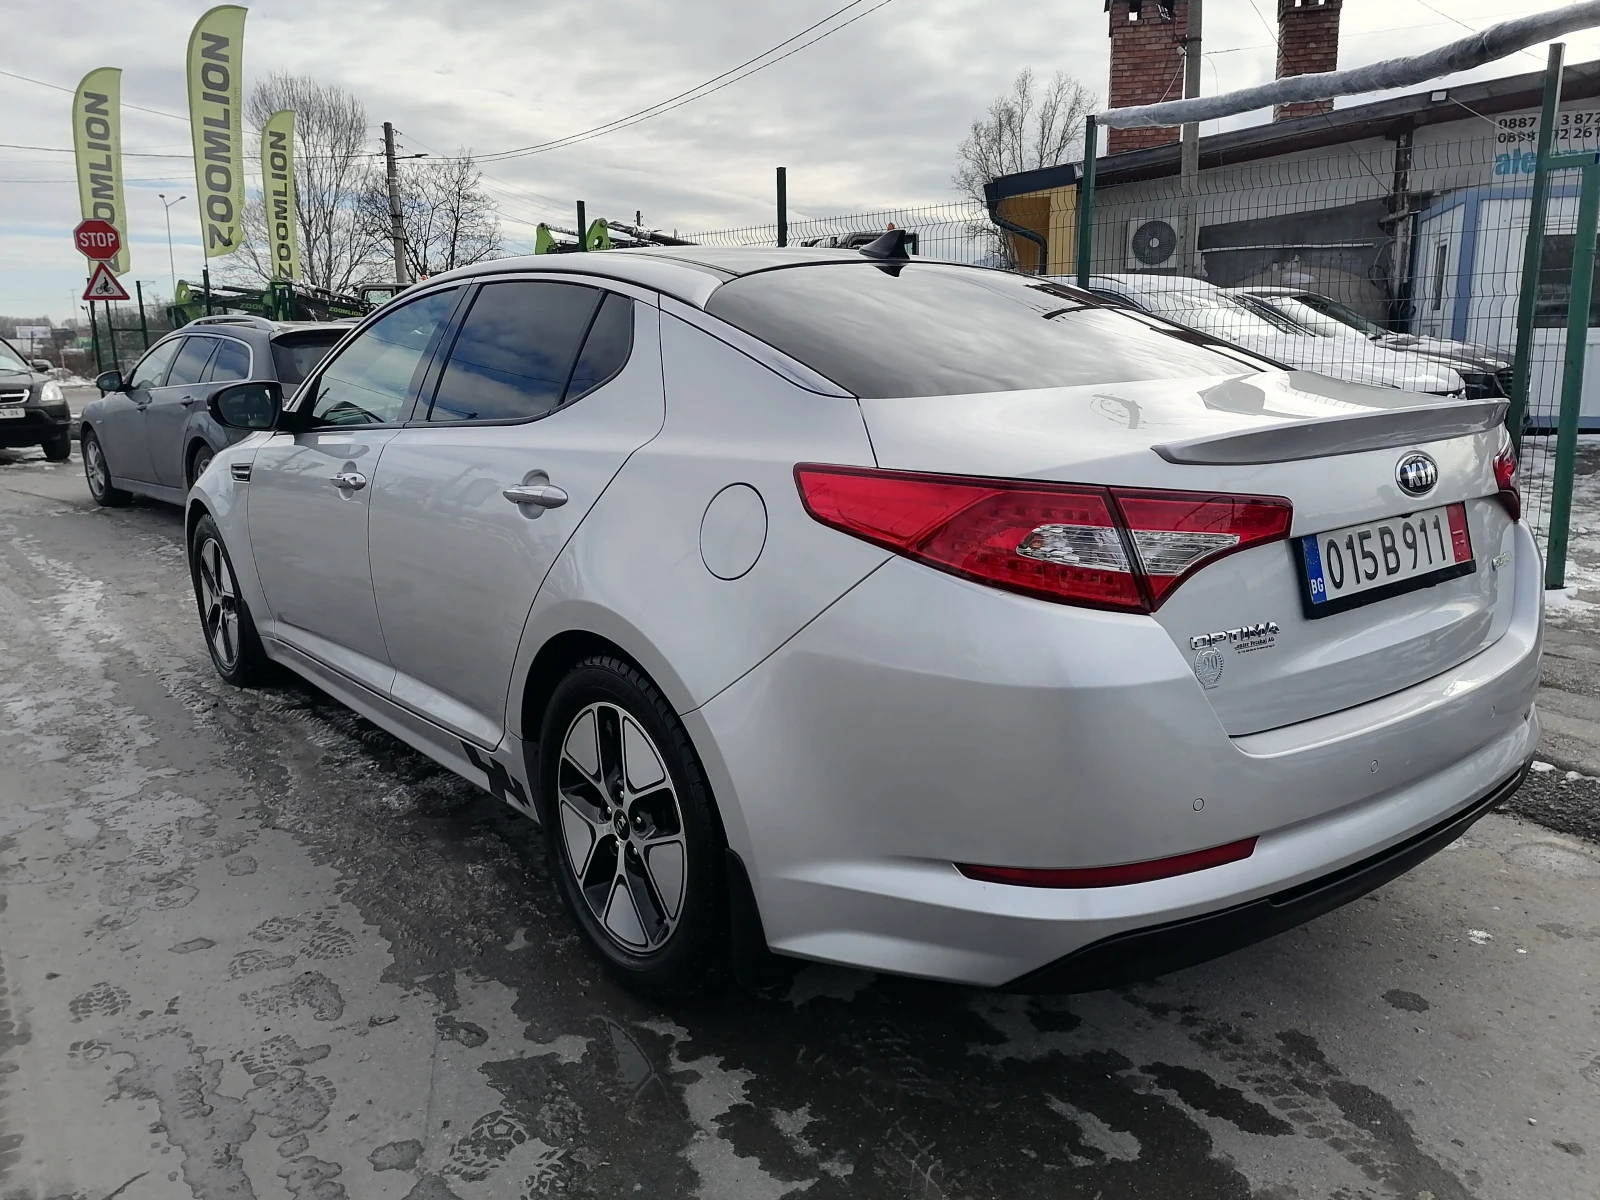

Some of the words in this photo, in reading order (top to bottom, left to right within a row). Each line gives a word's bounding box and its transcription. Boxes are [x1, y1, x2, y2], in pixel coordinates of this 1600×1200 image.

[1499, 117, 1537, 129] 0887
[201, 32, 233, 249] ZOOMLION
[268, 131, 294, 278] ZOOMLION
[79, 232, 116, 247] STOP
[1404, 460, 1437, 487] KIA
[1326, 515, 1447, 590] 015B911
[1310, 578, 1324, 595] BG
[1189, 621, 1280, 650] OPTIMA
